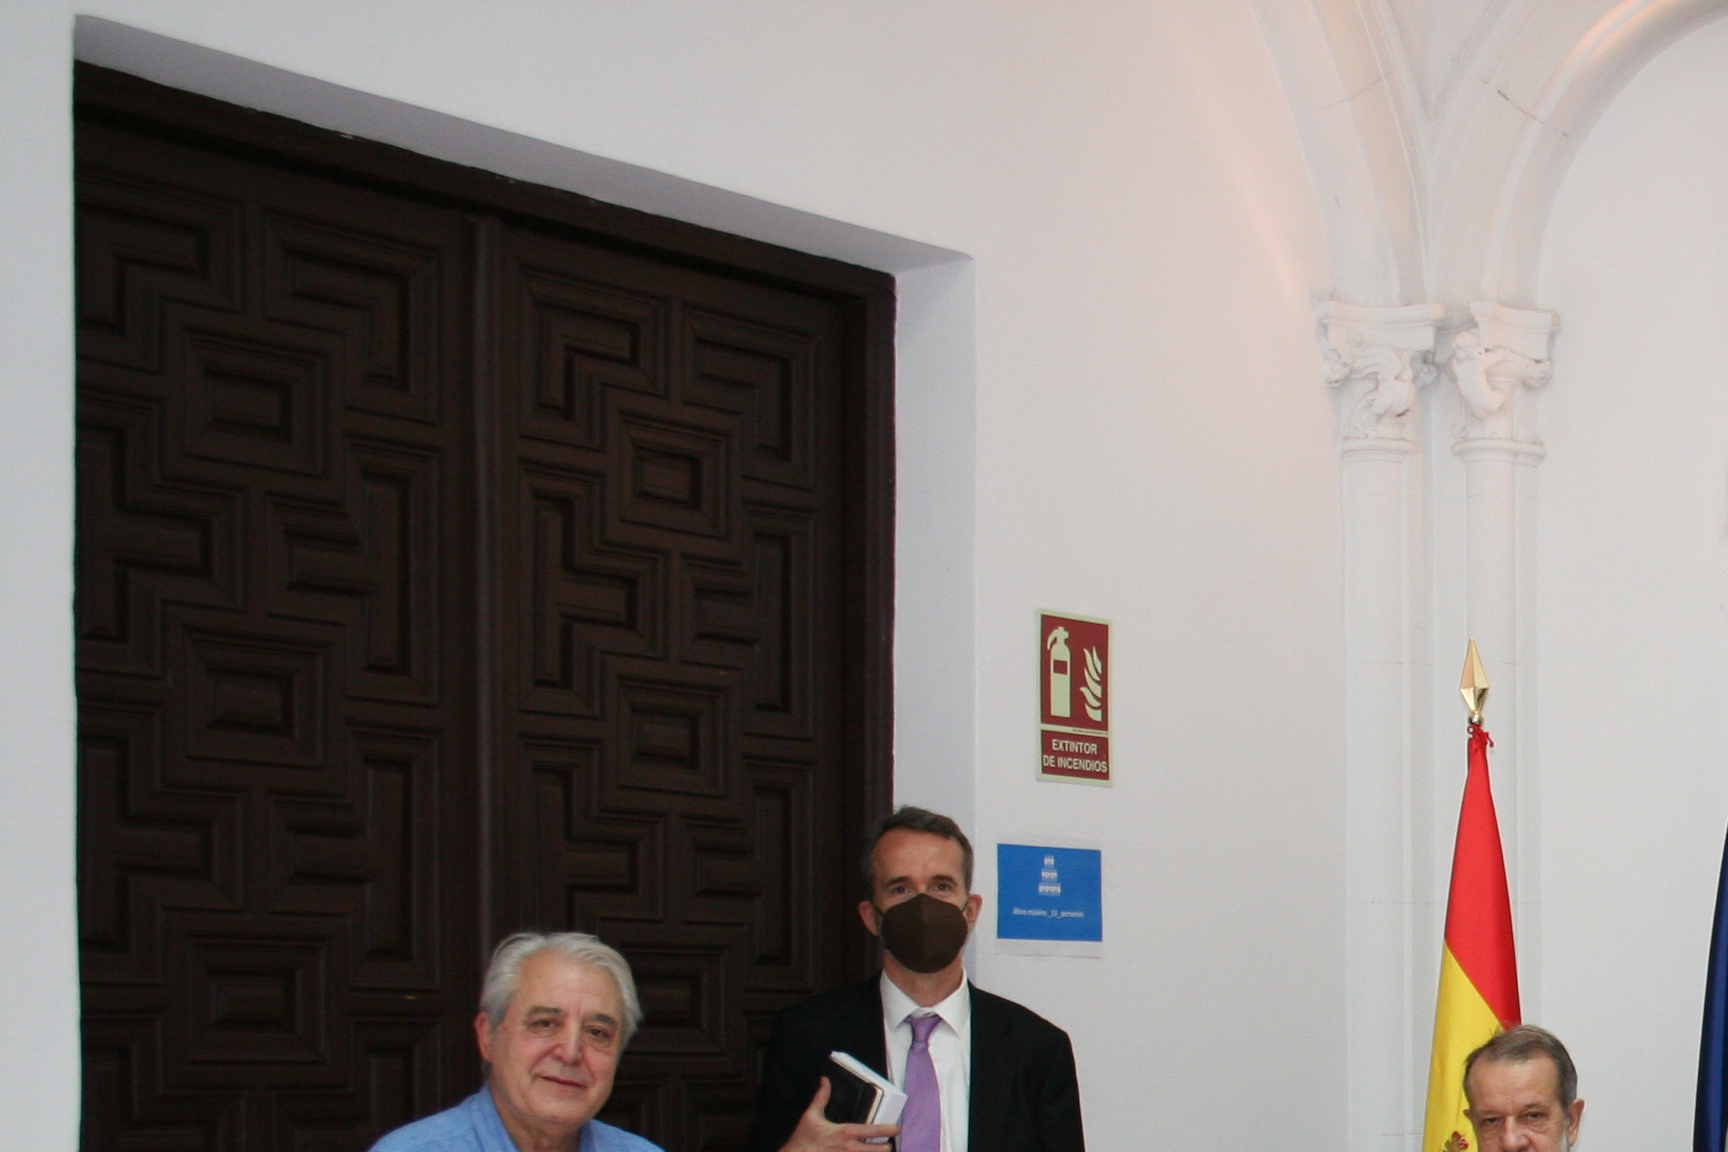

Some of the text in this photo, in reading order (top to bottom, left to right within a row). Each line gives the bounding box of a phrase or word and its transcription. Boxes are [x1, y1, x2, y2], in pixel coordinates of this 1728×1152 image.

[1052, 739, 1097, 755] EXTINTOR
[1043, 755, 1108, 773] DE INCENDIOS
